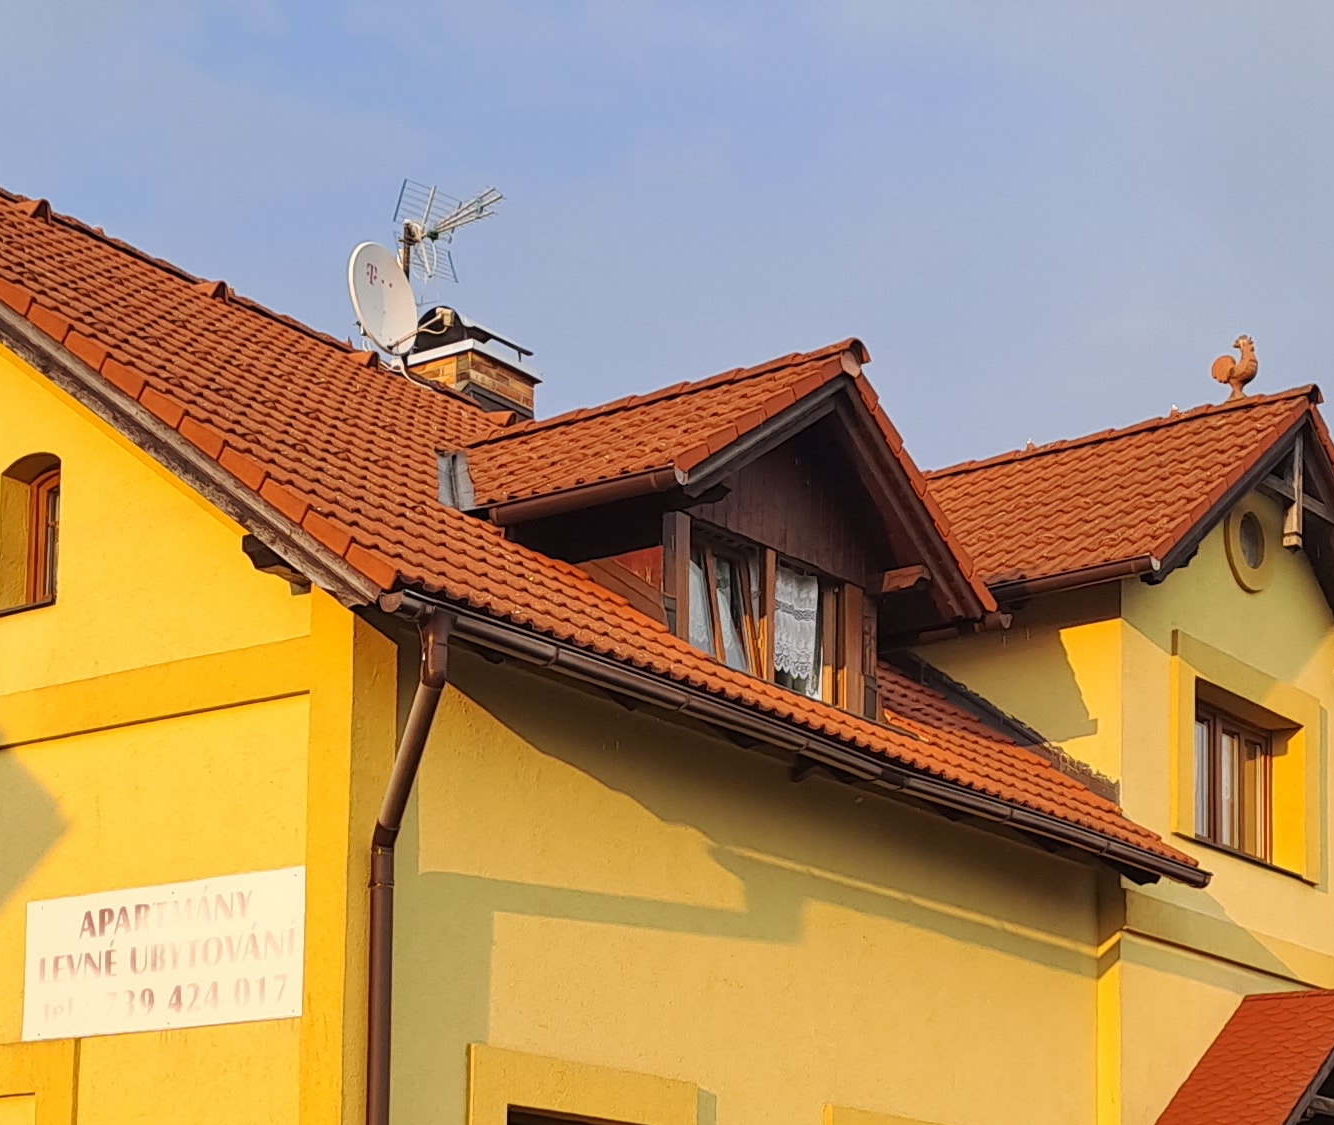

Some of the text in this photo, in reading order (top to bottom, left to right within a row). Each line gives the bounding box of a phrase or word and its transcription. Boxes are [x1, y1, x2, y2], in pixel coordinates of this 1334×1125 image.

[78, 885, 253, 939] APARTMÁNY
[38, 918, 297, 984] LEVNÉ UBYTOVÁNÍ
[106, 987, 155, 1017] 739
[167, 980, 219, 1013] 424
[233, 973, 288, 1008] 017
